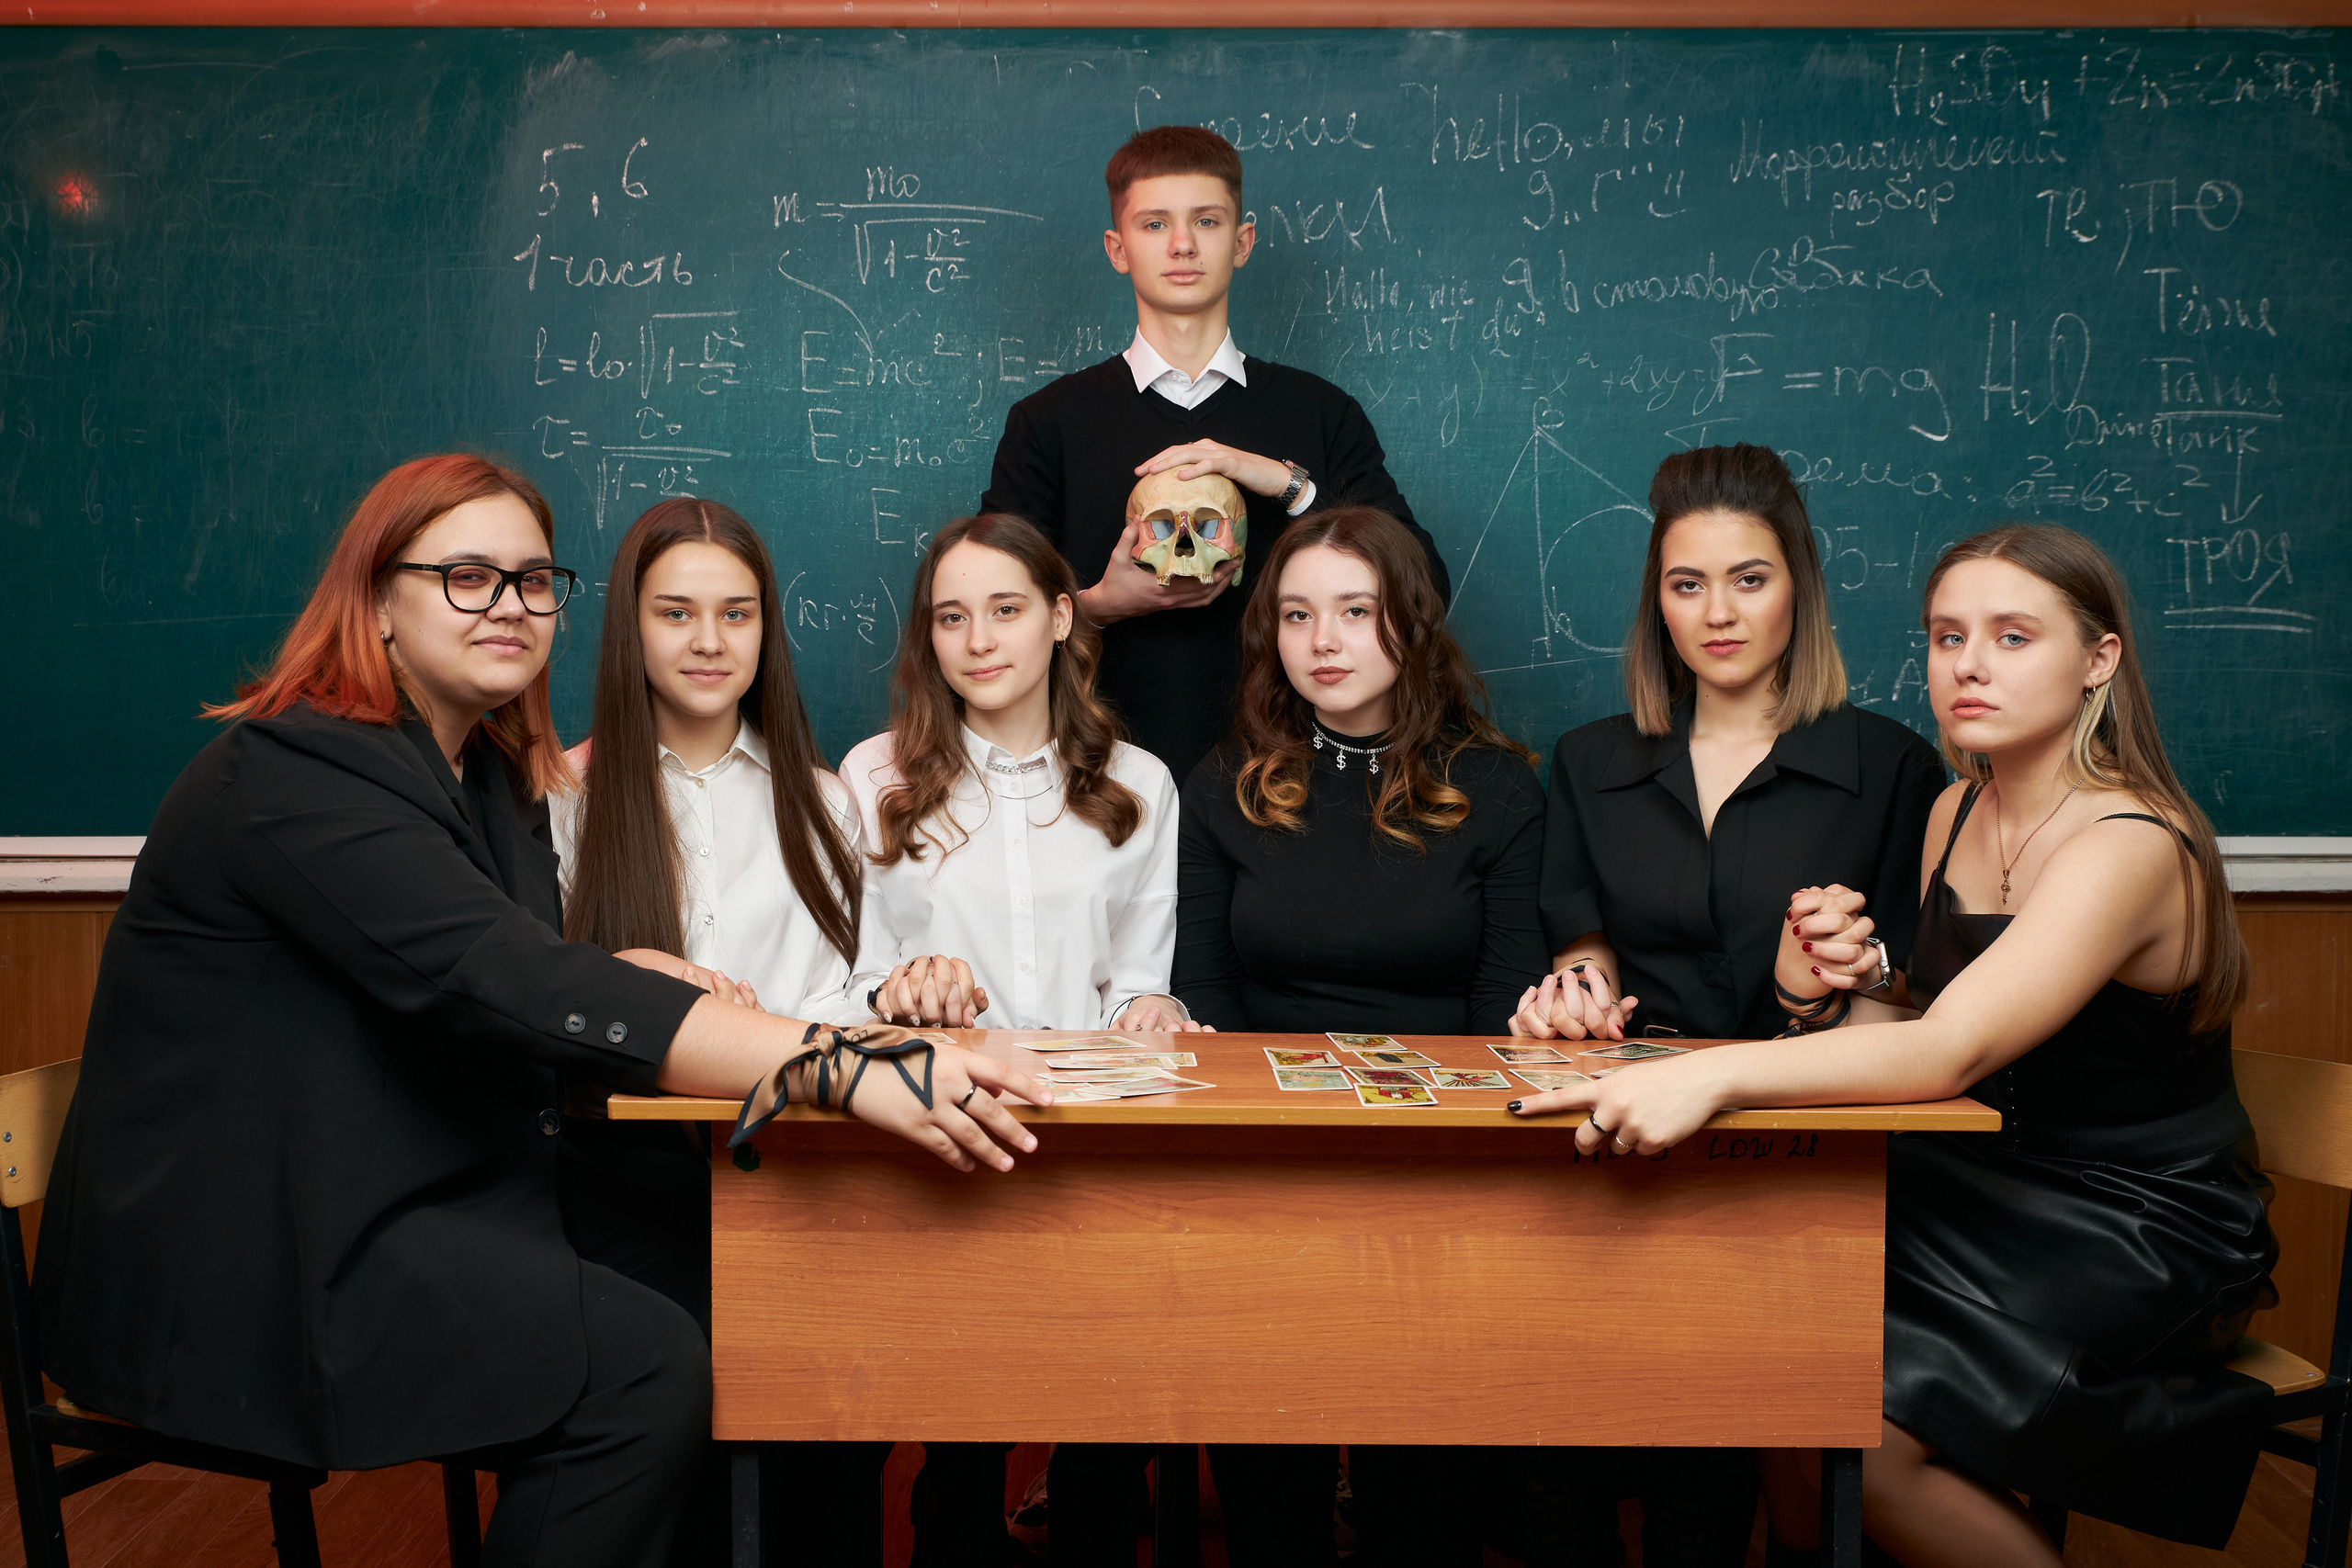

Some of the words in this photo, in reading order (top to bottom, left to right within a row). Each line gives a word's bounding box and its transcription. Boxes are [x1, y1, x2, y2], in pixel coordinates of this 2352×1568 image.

[1830, 171, 1955, 241] разбор
[550, 252, 695, 287] часть
[2166, 527, 2295, 606] ТРОЯ
[1788, 1133, 1819, 1158] 28
